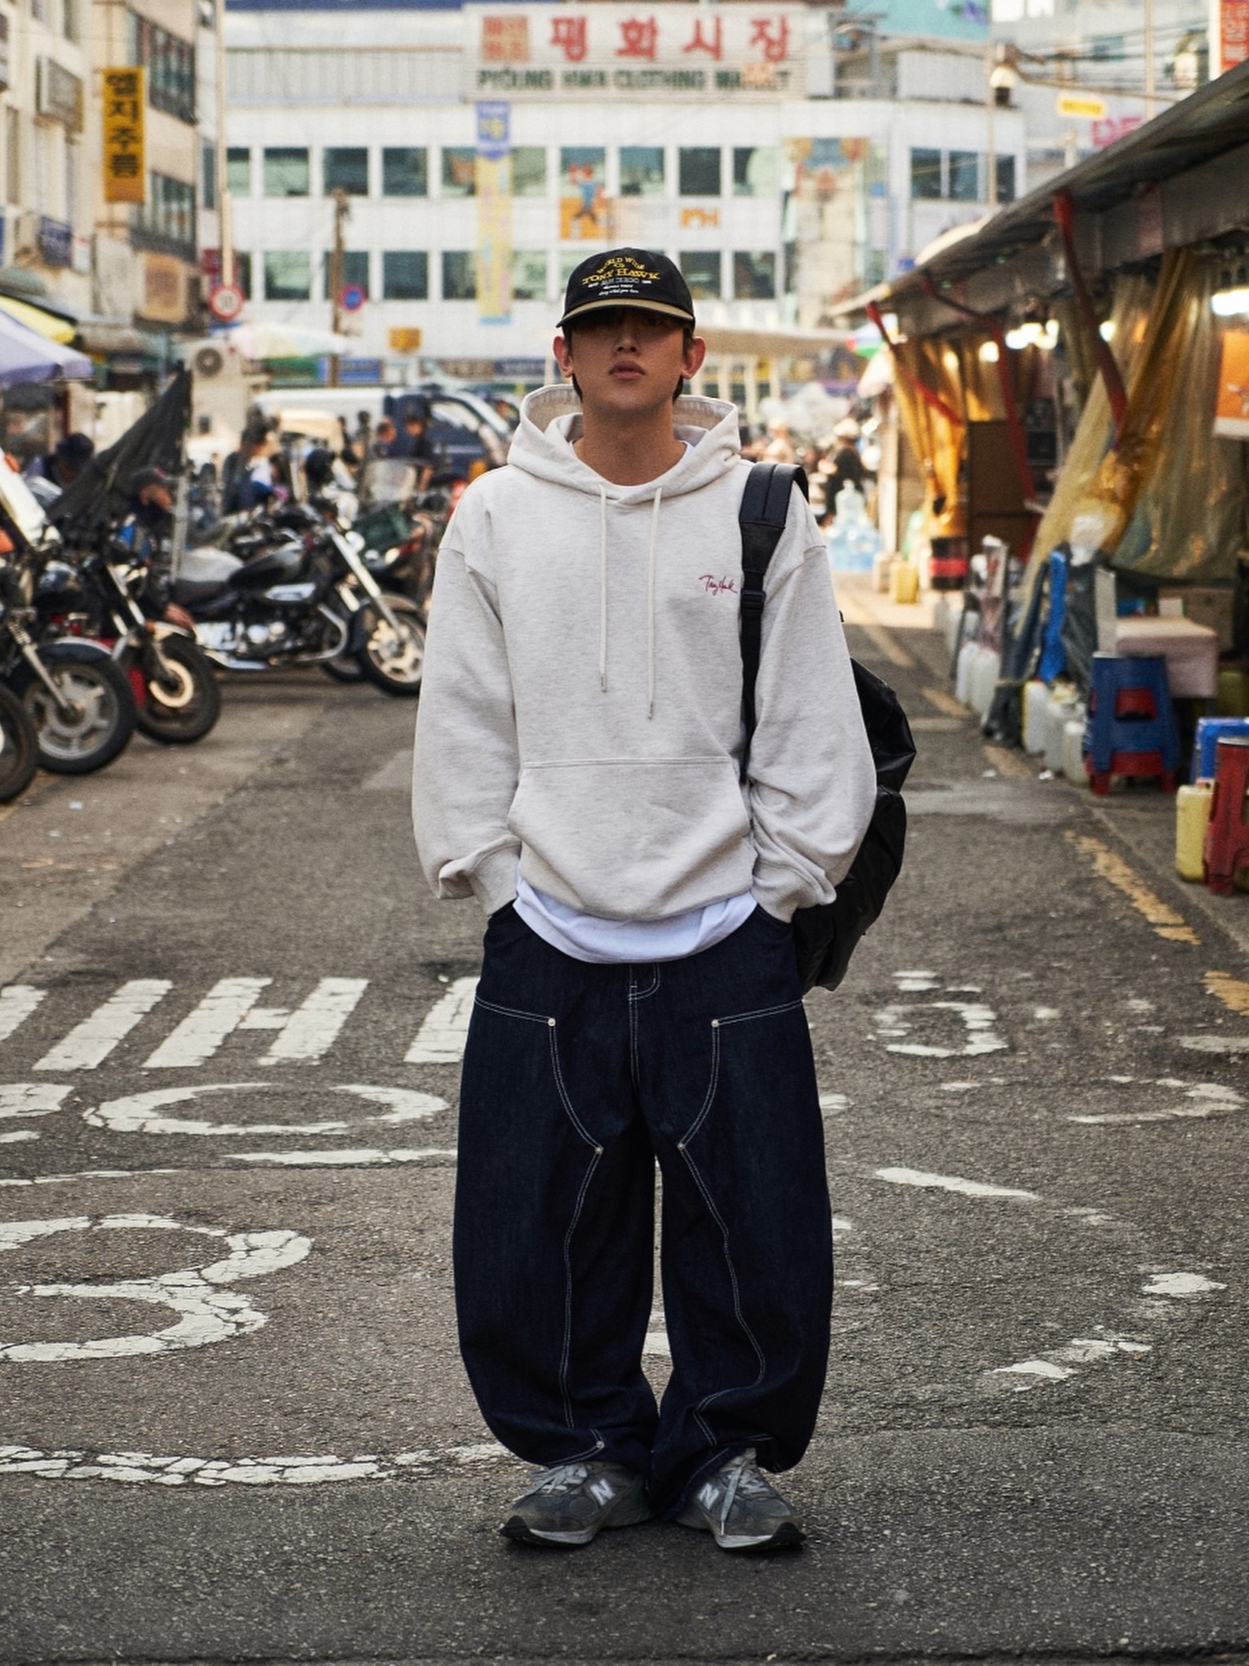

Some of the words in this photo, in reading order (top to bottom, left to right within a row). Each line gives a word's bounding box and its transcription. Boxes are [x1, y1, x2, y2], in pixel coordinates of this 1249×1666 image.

[550, 15, 790, 63] 평화시장
[582, 269, 614, 285] TONY
[616, 268, 661, 280] HAWK
[589, 1477, 616, 1506] N
